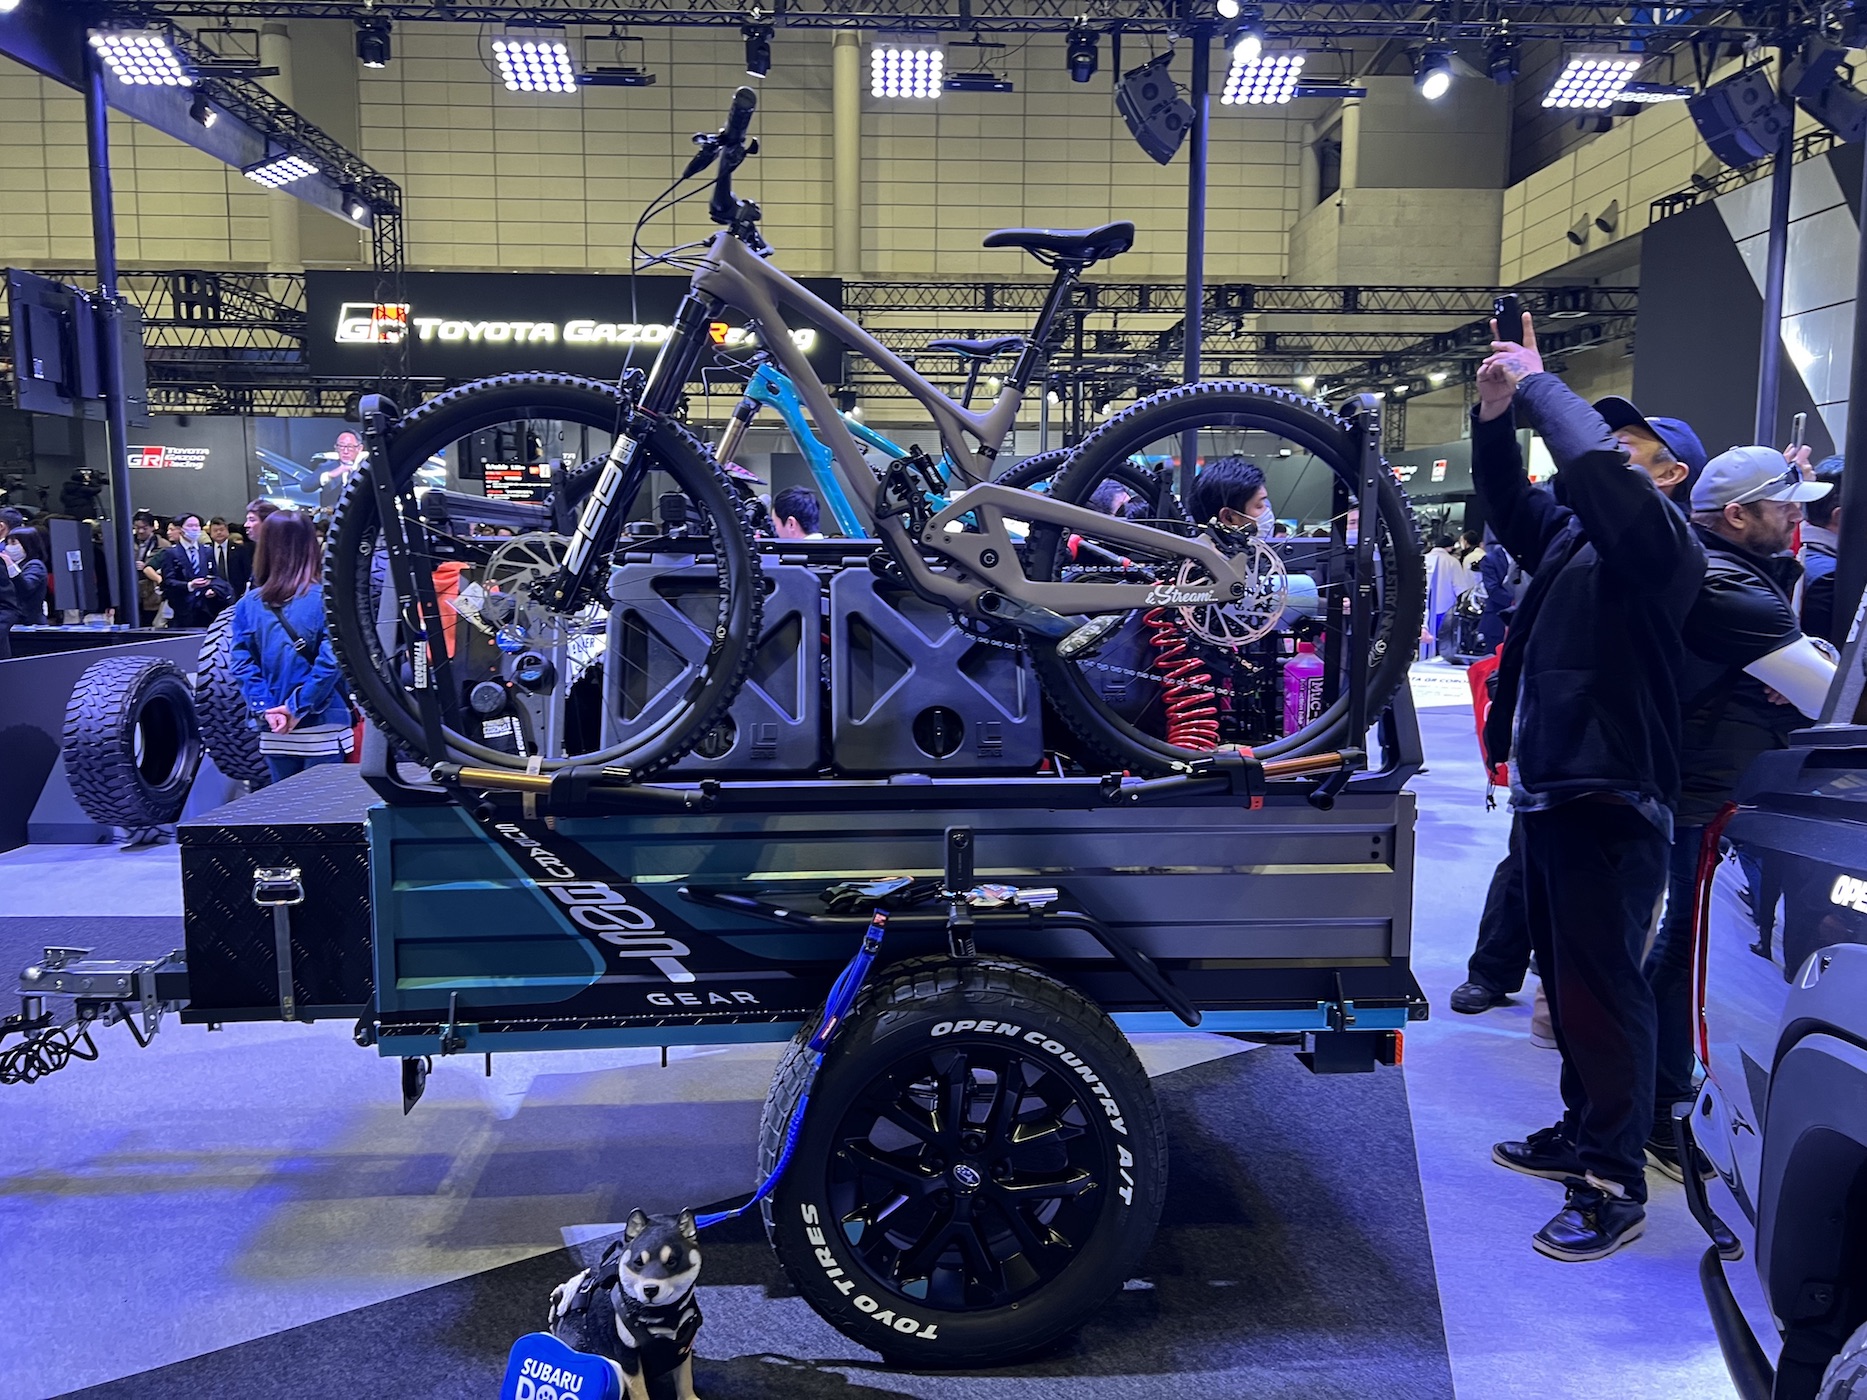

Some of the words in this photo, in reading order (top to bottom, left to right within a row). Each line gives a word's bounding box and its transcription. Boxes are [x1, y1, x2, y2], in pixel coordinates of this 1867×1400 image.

[127, 452, 162, 467] GR
[495, 823, 576, 879] SUBARU
[646, 991, 760, 1006] GEAR
[930, 1020, 1022, 1037] OPEN
[1023, 1031, 1129, 1136] COUNTRY
[1116, 1144, 1135, 1206] A/T
[800, 1203, 856, 1296] TIRES
[852, 1294, 938, 1340] TOYO
[520, 1357, 584, 1393] SUBARU
